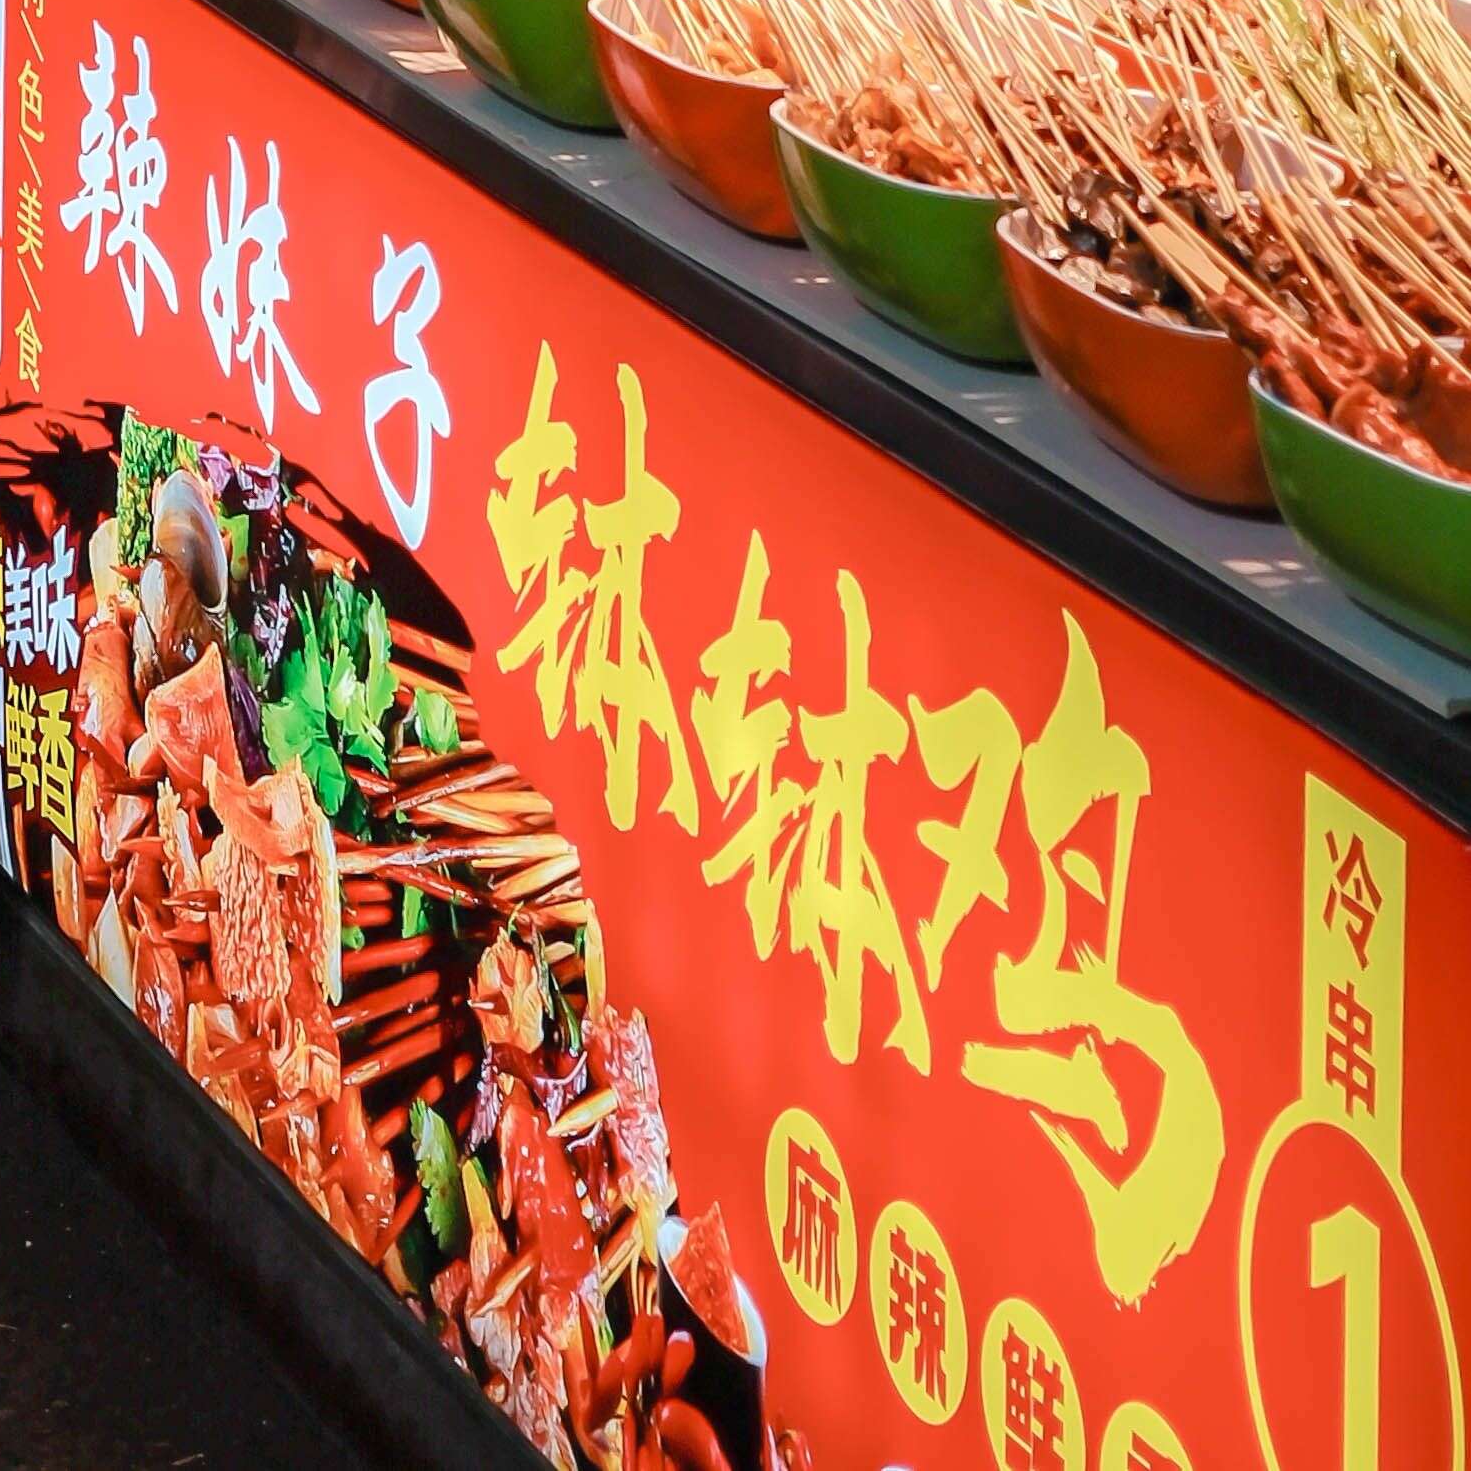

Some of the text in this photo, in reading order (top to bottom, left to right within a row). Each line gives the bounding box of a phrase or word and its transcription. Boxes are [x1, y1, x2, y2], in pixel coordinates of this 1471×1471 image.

[60, 18, 452, 551] 辣妹子
[486, 340, 1227, 1310] 钵钵鸡
[1321, 829, 1385, 1121] 冷串
[782, 1134, 1187, 1471] 麻辣鲜
